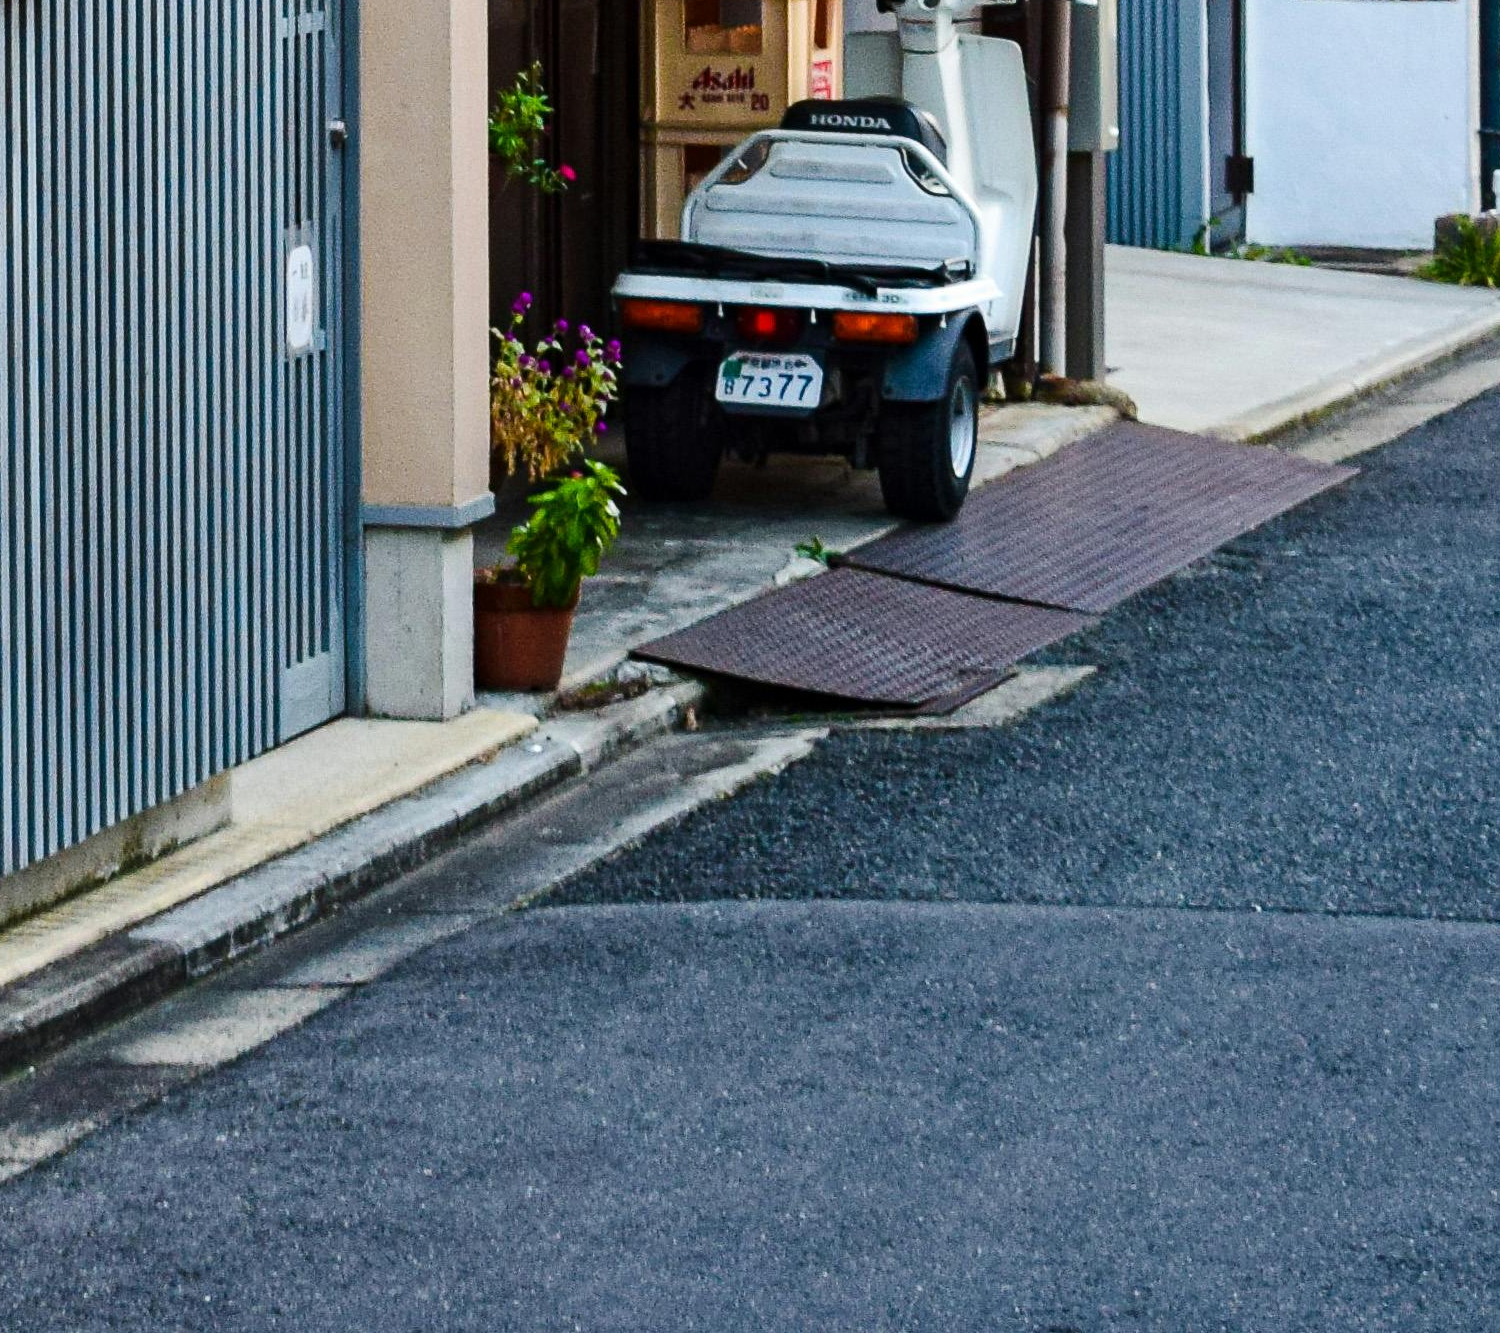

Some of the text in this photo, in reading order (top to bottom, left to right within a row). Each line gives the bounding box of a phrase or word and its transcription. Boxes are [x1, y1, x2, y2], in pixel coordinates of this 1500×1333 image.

[692, 64, 756, 91] Asahi
[678, 92, 696, 111] 大
[751, 93, 770, 112] 20
[809, 113, 892, 130] HONDA
[741, 373, 814, 402] 7377
